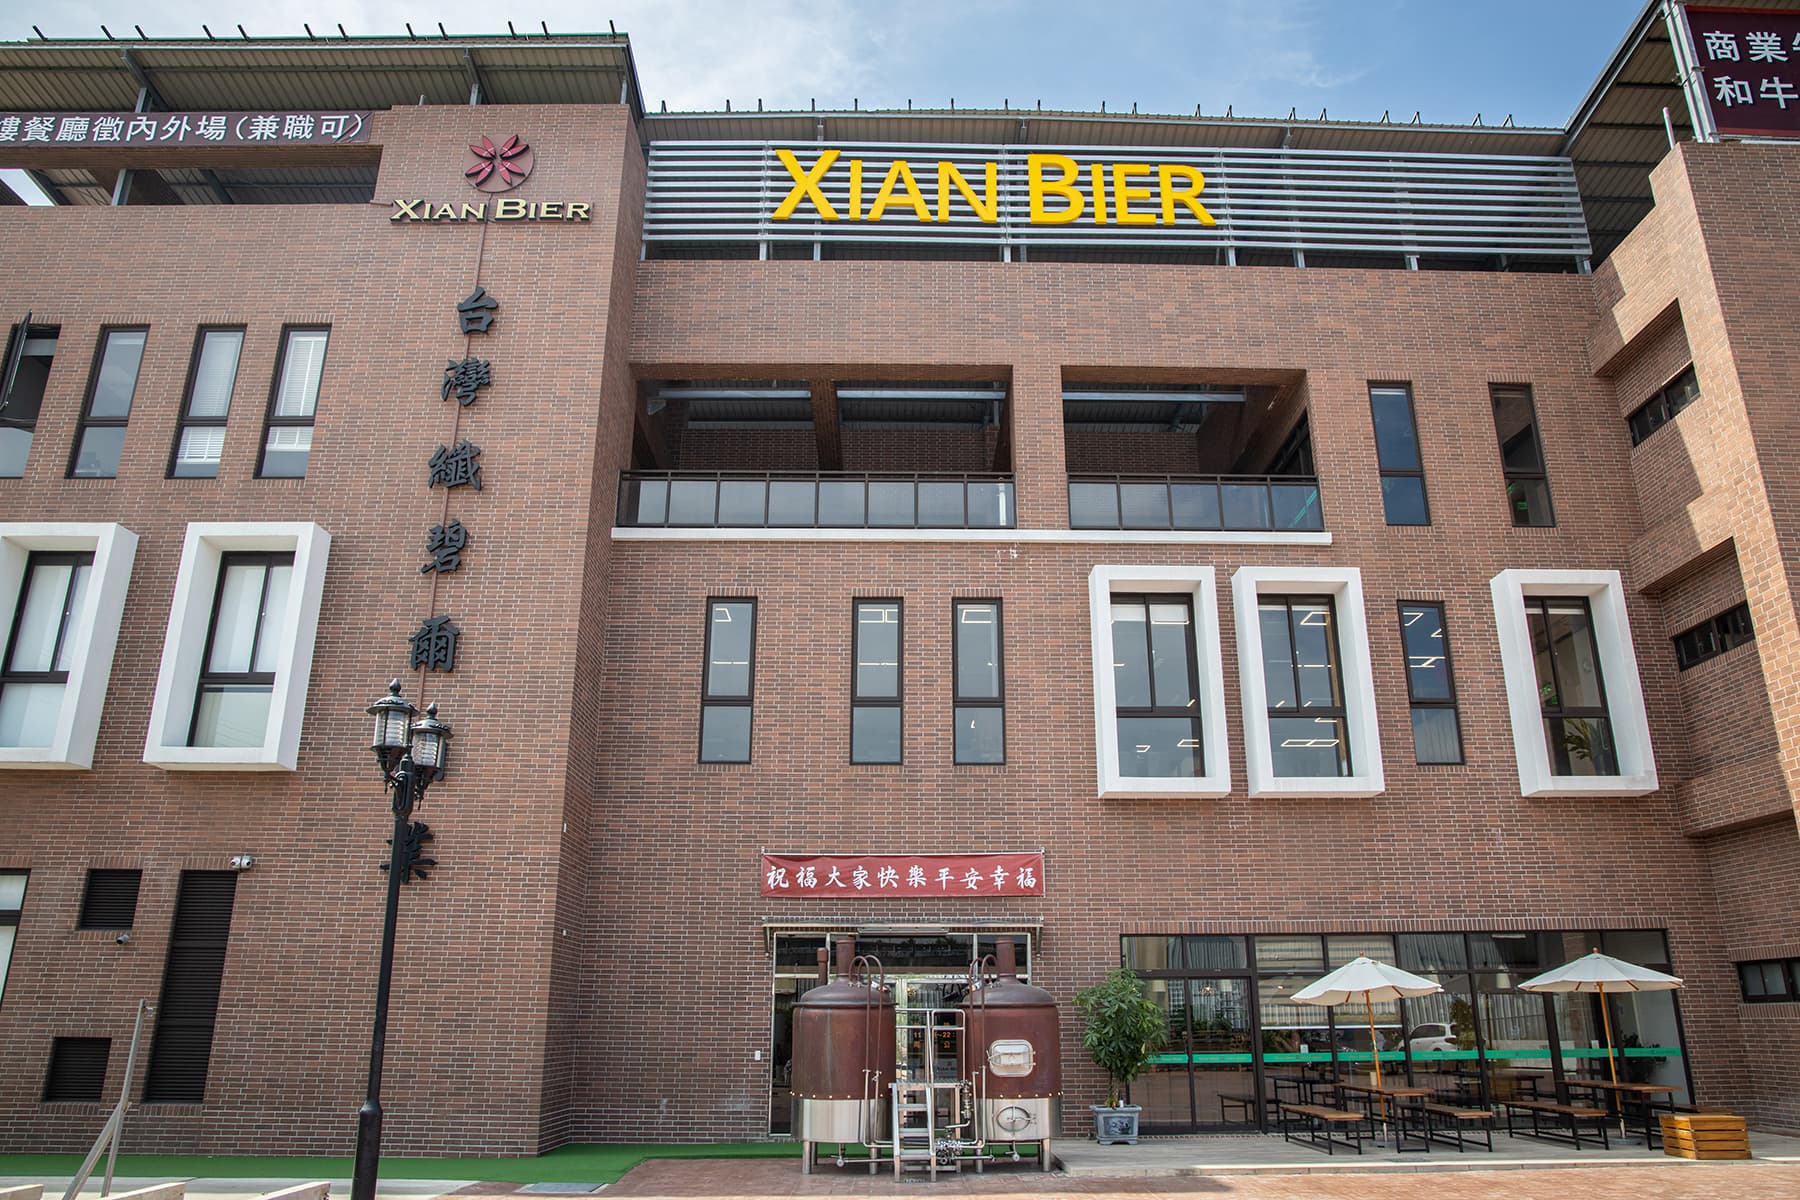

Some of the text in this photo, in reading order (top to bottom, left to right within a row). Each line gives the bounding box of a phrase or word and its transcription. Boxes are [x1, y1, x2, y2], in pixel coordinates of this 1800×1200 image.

[1703, 30, 1800, 62] 商業
[1713, 76, 1799, 109] 和牛
[772, 149, 1217, 226] XIAN BIER
[390, 198, 592, 222] XIAN BIER
[766, 864, 1038, 890] 祝福大家快樂平安幸福
